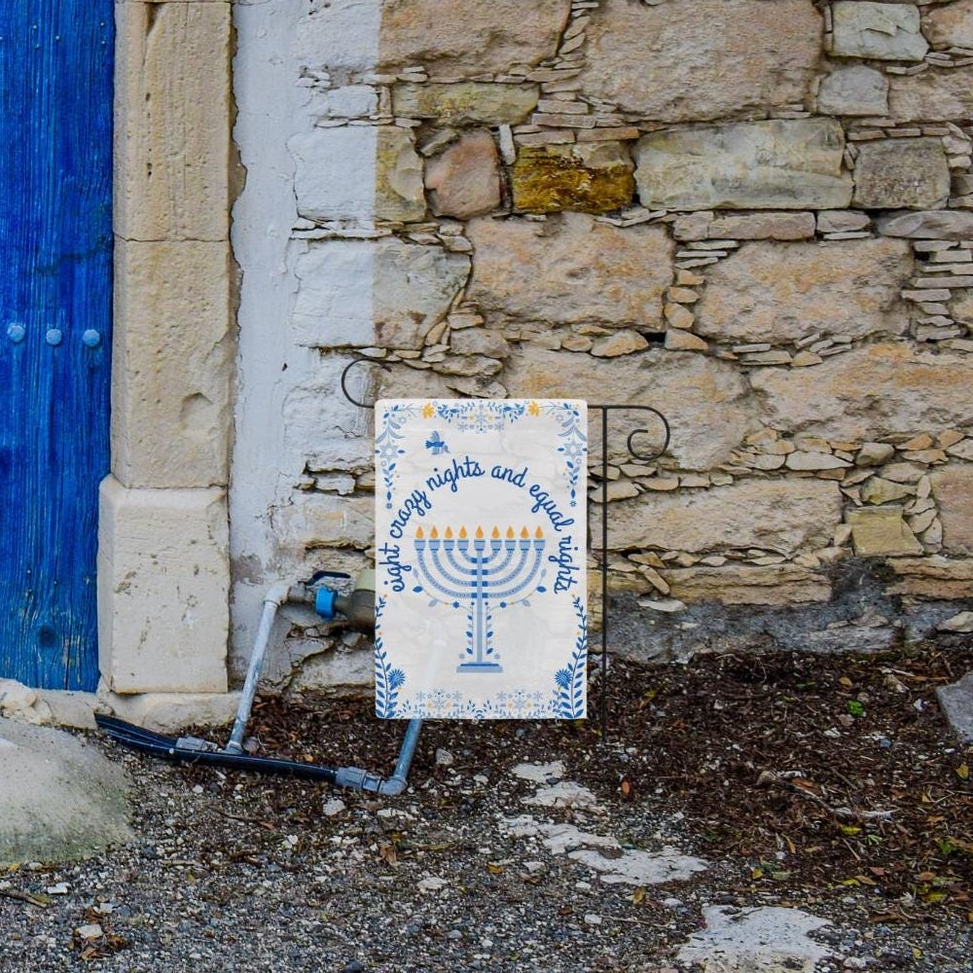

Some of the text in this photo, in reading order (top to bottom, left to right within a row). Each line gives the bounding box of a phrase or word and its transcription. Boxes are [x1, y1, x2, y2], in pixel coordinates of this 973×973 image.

[378, 456, 580, 594] eight crazy nights and equal rights
